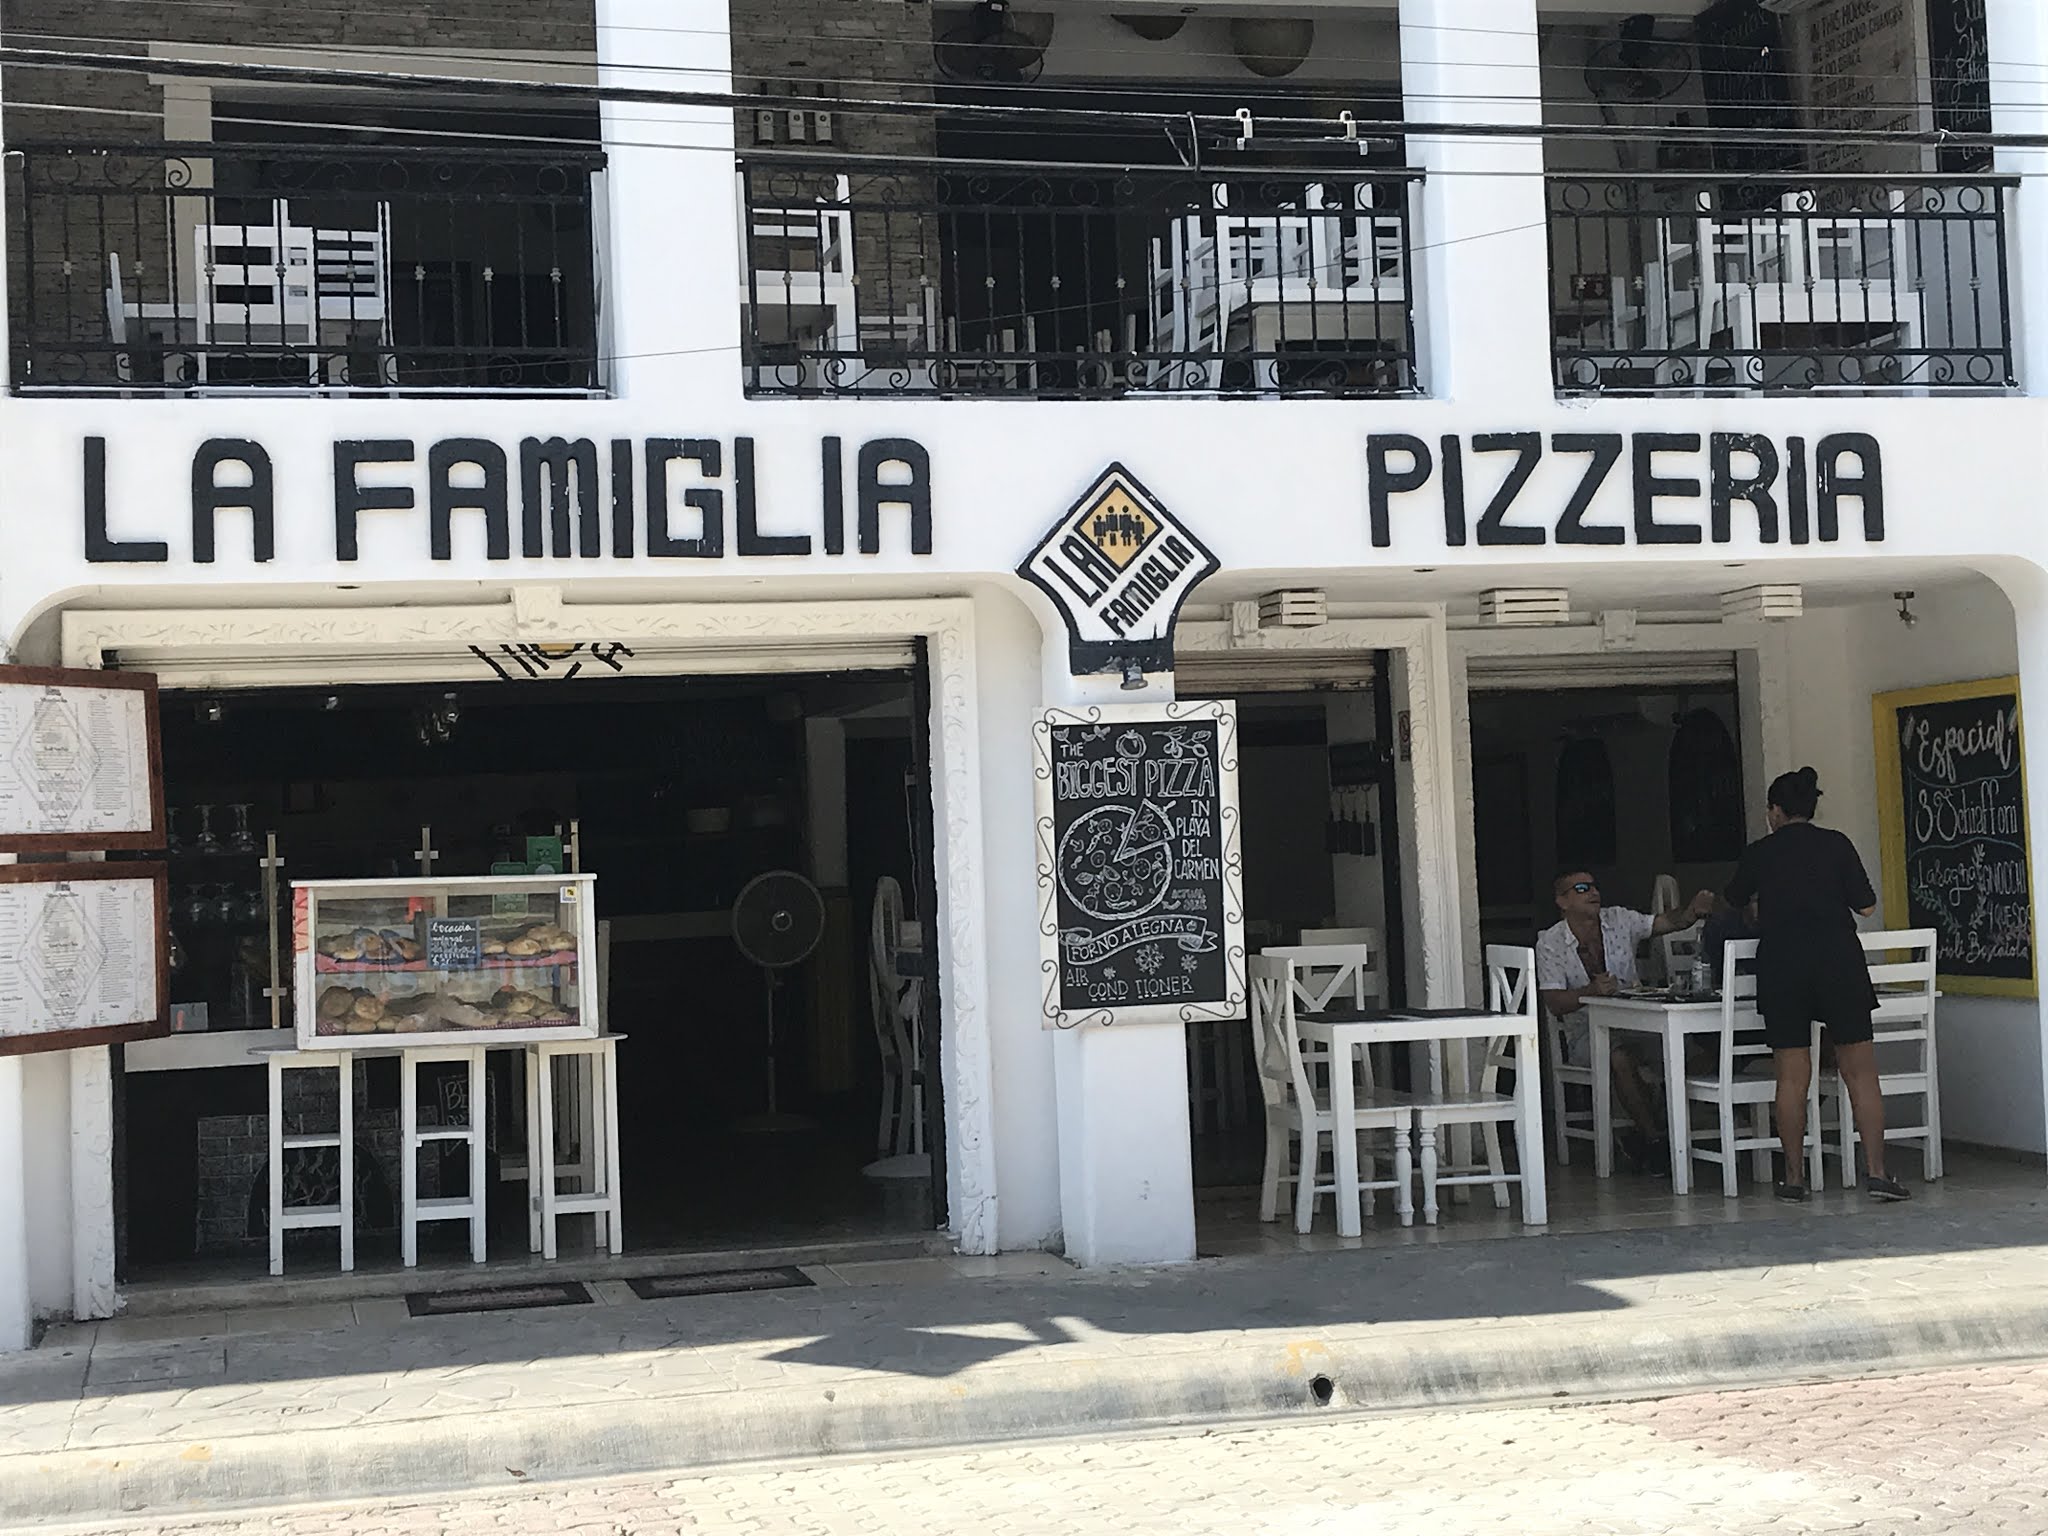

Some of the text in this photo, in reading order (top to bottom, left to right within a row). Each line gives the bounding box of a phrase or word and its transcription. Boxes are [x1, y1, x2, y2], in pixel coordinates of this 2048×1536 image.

[83, 436, 932, 562] LA FAMIGLIA
[1367, 432, 1885, 548] PIZZERIA
[1043, 535, 1117, 608] LA
[1099, 535, 1194, 638] FAMIGLIA
[1060, 742, 1084, 758] THE
[1056, 757, 1215, 800] BIGGEST PIZZA
[1190, 799, 1210, 817] IN
[1176, 817, 1211, 838] PLAYA
[1182, 839, 1203, 858] DEL
[1174, 858, 1220, 881] CARMEN
[1071, 933, 1119, 961] FORNO
[1132, 920, 1185, 938] LEGNA
[1065, 967, 1090, 985] AIR
